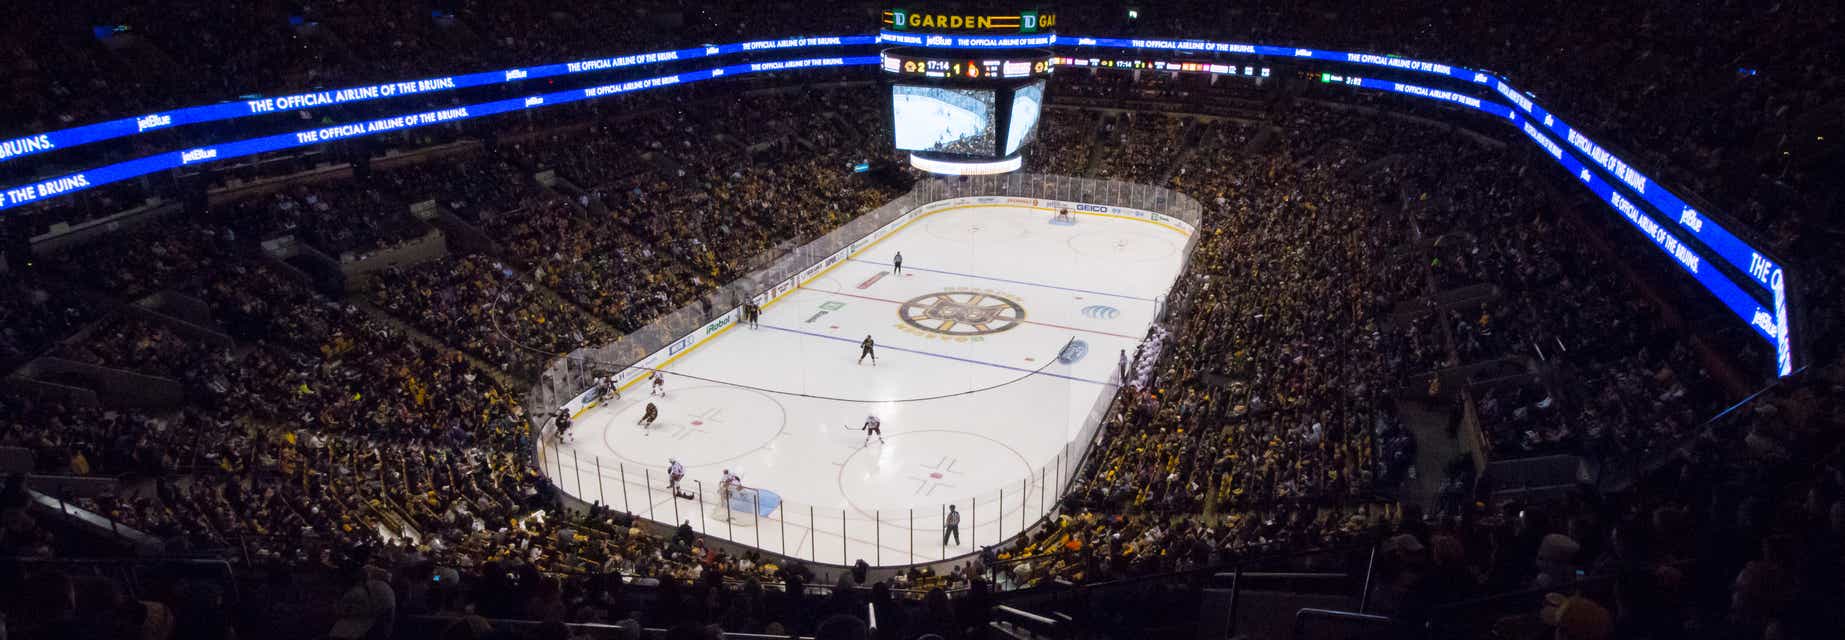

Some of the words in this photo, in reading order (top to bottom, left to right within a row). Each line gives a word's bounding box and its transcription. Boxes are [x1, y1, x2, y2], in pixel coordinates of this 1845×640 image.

[909, 14, 991, 29] GARDEN
[1146, 40, 1176, 49] OFFICIAL
[567, 62, 581, 72] THE
[581, 59, 611, 71] OFFICIAL
[612, 56, 636, 67] AIRLINE
[636, 55, 645, 64] OF
[645, 53, 657, 62] THE
[918, 61, 925, 73] 2
[927, 60, 950, 70] 17:14
[1347, 53, 1361, 62] THE
[1361, 55, 1387, 66] OFFICIAL
[1411, 60, 1420, 70] OF
[1421, 62, 1433, 71] THE
[248, 98, 274, 113] THE
[276, 92, 333, 109] OFFICIAL
[335, 86, 379, 102] AIRLINE
[380, 83, 397, 97] OF
[397, 80, 417, 94] THE
[418, 77, 456, 92] BRUINS.
[585, 87, 596, 97] THE
[596, 84, 622, 95] OFFICIAL
[1405, 86, 1429, 97] OFFICIAL
[136, 114, 171, 132] jetBlue
[297, 131, 318, 143] THE
[319, 123, 366, 140] OFFICIAL
[367, 117, 404, 132] AIRLINE
[405, 114, 419, 126] OF
[419, 112, 437, 124] THE
[437, 107, 469, 121] BRUINS.
[181, 149, 217, 164] jetBlue
[7, 186, 36, 204] THE
[37, 174, 90, 196] BRUINS.
[1076, 203, 1107, 213] GEICO
[1656, 228, 1667, 245] OF
[1665, 234, 1678, 255] THE
[1749, 252, 1772, 284] THE
[706, 315, 730, 335] iRobot
